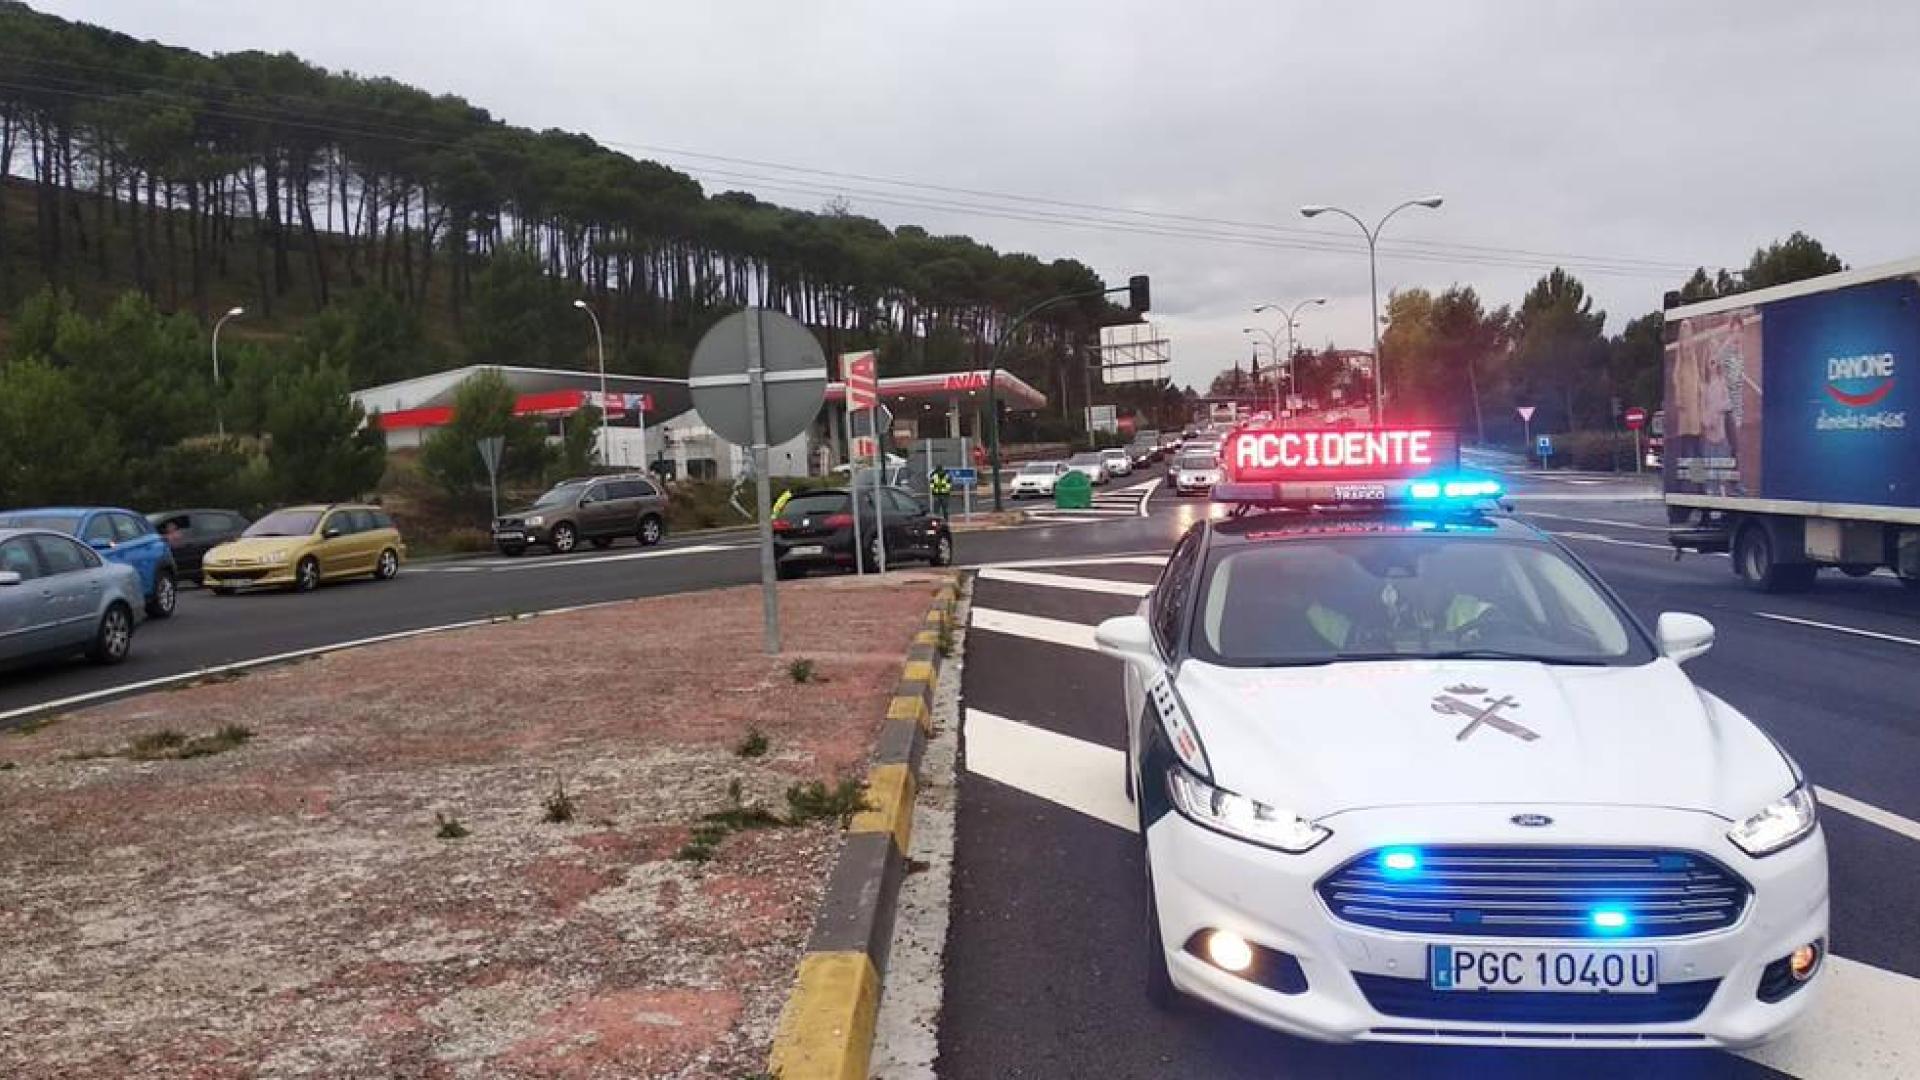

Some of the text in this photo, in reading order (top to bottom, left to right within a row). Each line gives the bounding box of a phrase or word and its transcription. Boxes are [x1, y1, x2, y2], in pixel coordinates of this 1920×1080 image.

[1827, 353, 1894, 380] DANONE
[1236, 430, 1432, 468] ACCIDENTE
[1454, 951, 1524, 985] PGC
